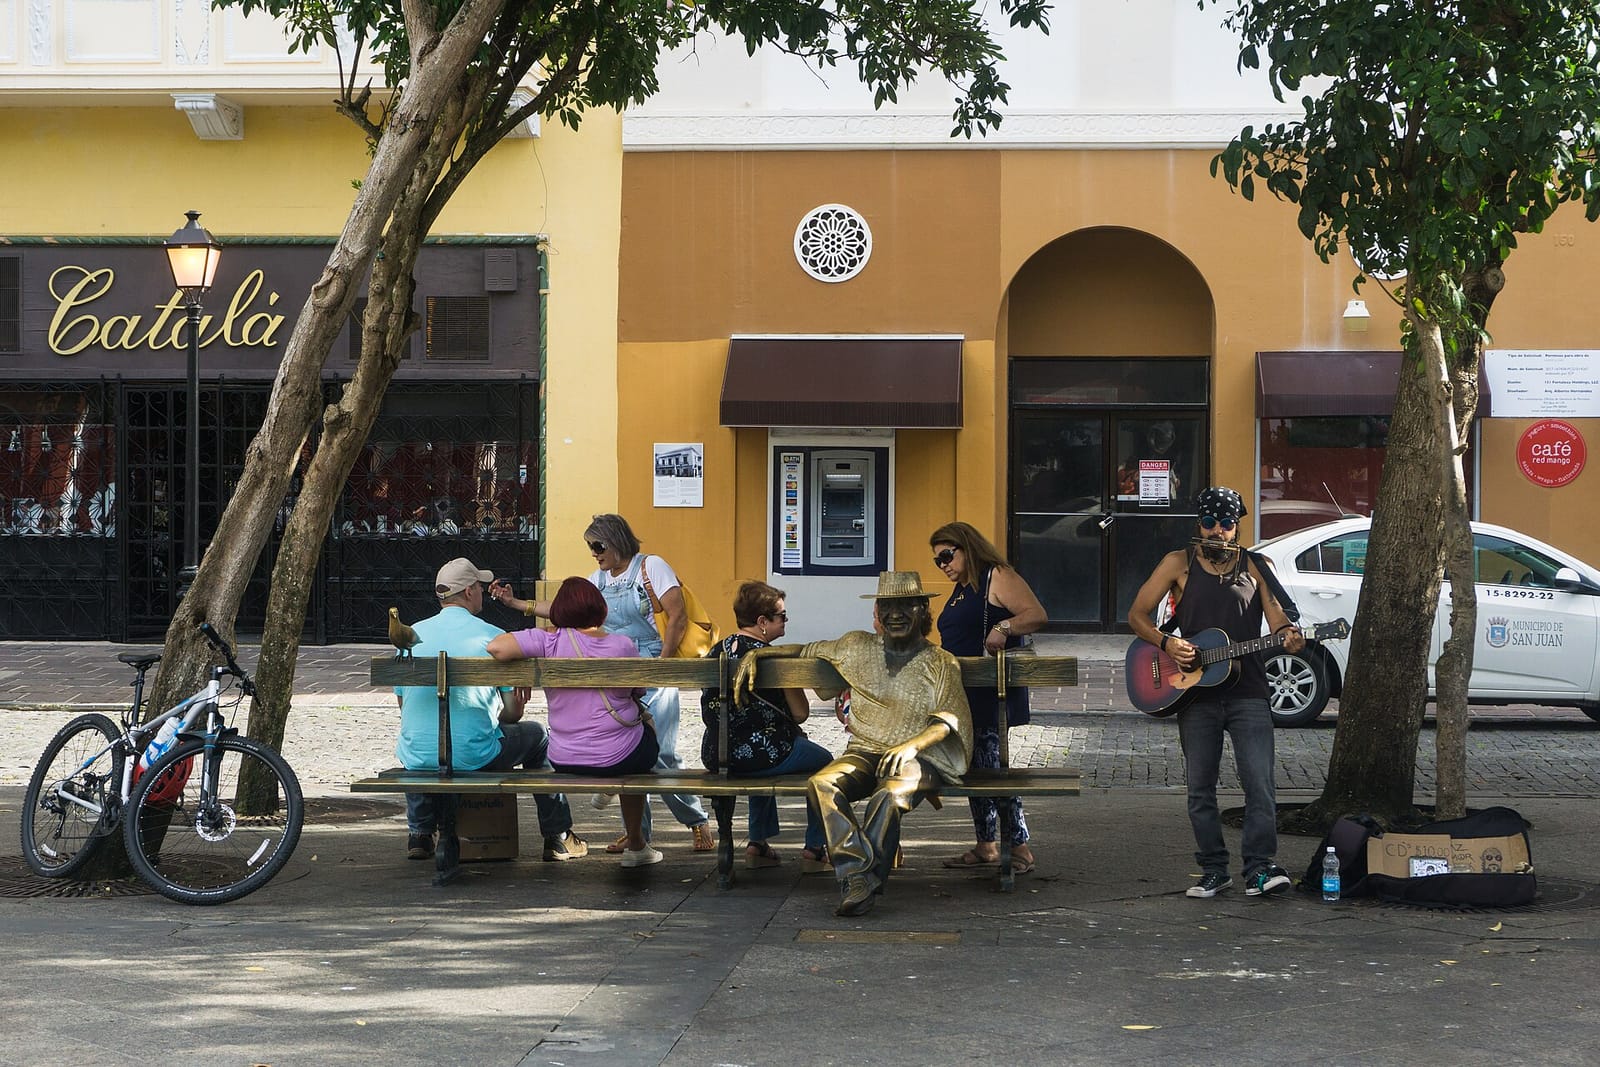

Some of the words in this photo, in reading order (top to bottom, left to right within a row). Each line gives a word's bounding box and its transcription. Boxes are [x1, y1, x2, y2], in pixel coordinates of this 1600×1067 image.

[1531, 440, 1572, 457] café
[1546, 457, 1571, 466] mango
[1486, 589, 1554, 600] 15-8292-22
[1512, 620, 1552, 632] MUNICIPIO
[1553, 621, 1563, 632] DE
[1512, 632, 1533, 646] SAN
[1535, 633, 1563, 647] JUAN
